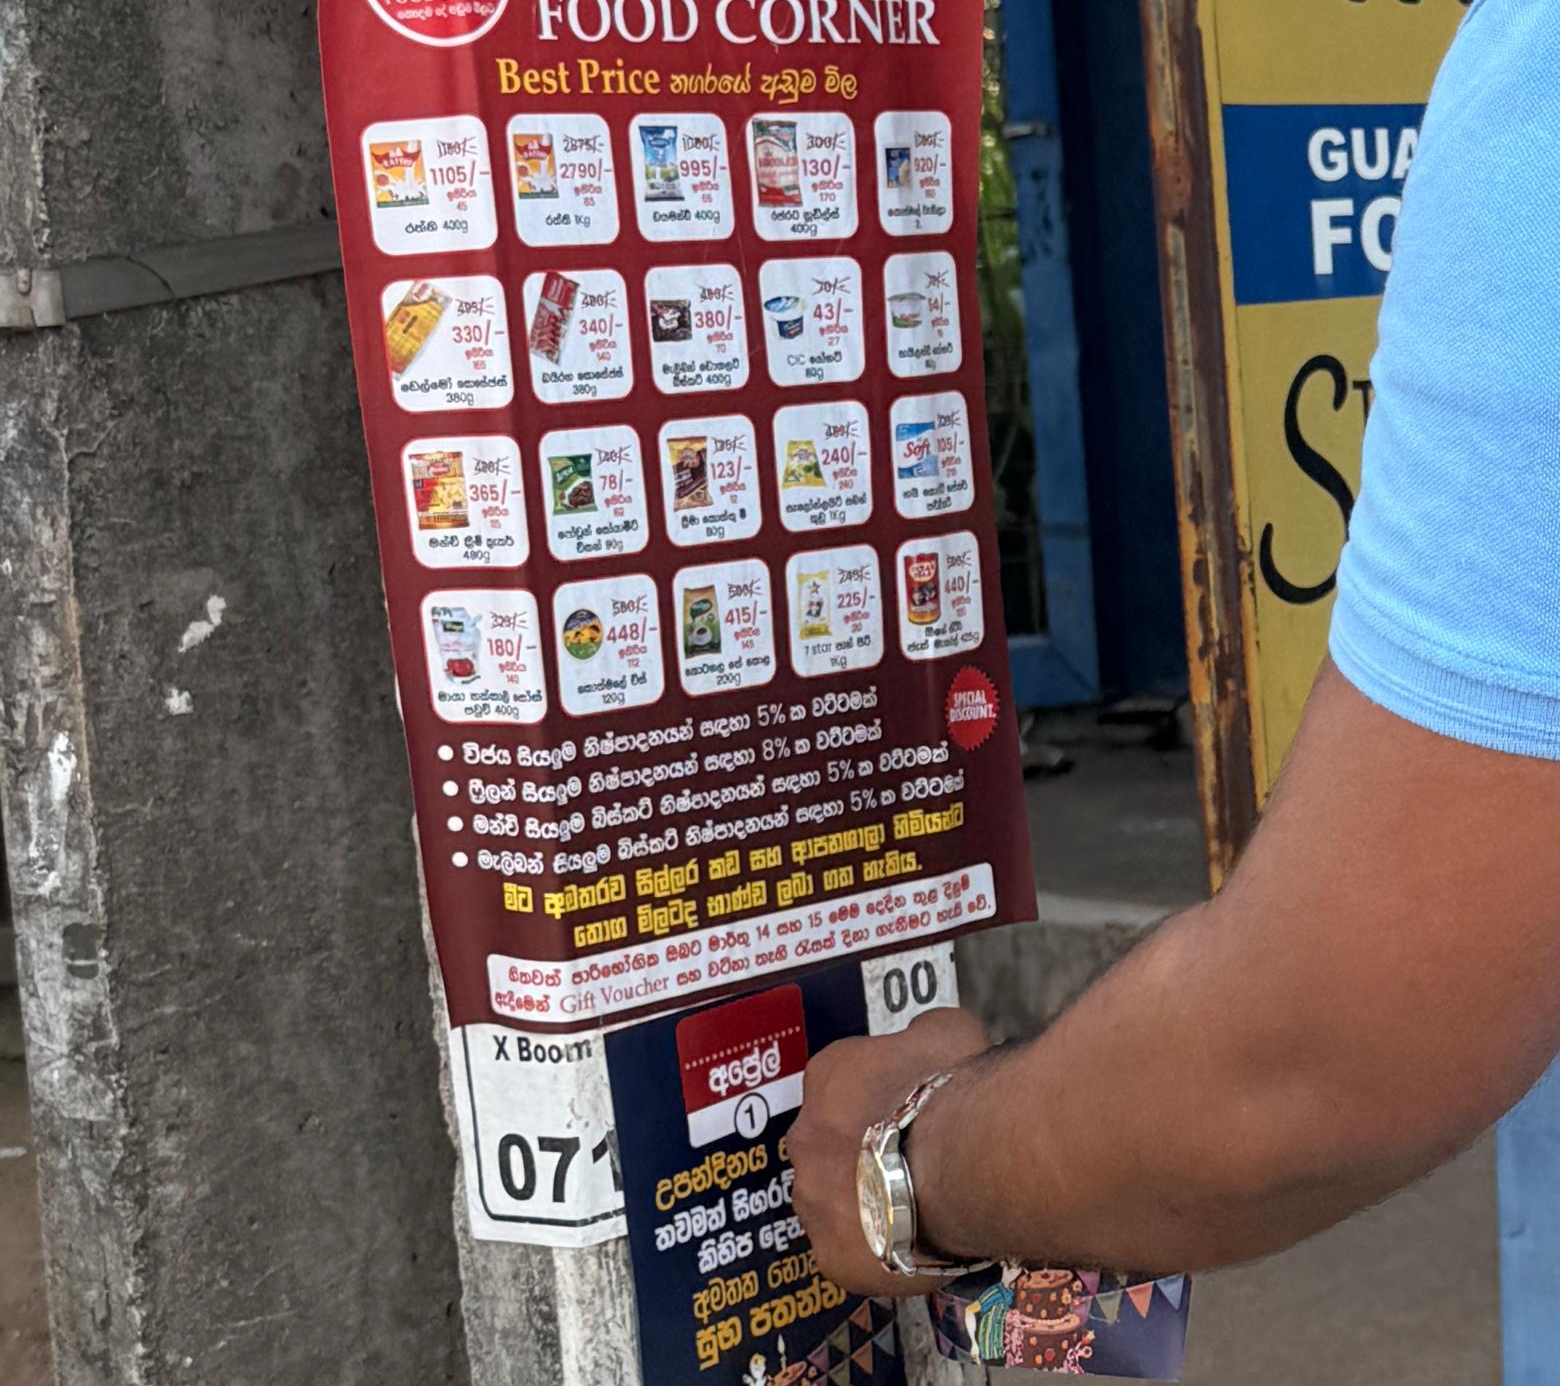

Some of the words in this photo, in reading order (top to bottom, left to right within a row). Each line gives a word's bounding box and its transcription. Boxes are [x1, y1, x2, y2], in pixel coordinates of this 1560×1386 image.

[495, 57, 572, 95] Best
[577, 57, 660, 96] Price
[669, 62, 752, 96] නගරයේ
[760, 67, 817, 105] අඩුම
[823, 65, 858, 101] මිල
[430, 159, 491, 187] 1105/-
[560, 158, 613, 182] 2790/-
[680, 155, 727, 179] 995/-
[801, 154, 851, 181] 130/-
[579, 313, 624, 338] 340/-
[694, 305, 743, 331] 380/-
[813, 298, 854, 326] 43/-
[452, 318, 506, 347] 330/-
[821, 440, 869, 467] 240/-
[903, 441, 931, 461] Soft
[599, 468, 634, 494] 78/-
[711, 455, 753, 481] 123/-
[469, 478, 522, 505] 365/-
[837, 586, 876, 609] 225/-
[724, 600, 768, 625] 415/-
[606, 615, 658, 643] 448/-
[487, 633, 537, 661] 180/-
[462, 741, 512, 765] විජය
[517, 740, 577, 770] සියලුම
[583, 718, 694, 758] නිෂ්පාදනයන්
[700, 711, 751, 739] සඳහා
[757, 703, 787, 726] 5%
[789, 704, 807, 721] ක
[812, 686, 878, 718] වට්ටමක්
[522, 776, 583, 806] සියලුම
[588, 752, 699, 794] නිෂ්පාදනයන්
[704, 745, 756, 771] සඳහා
[762, 736, 791, 761] 8%
[794, 738, 811, 755] ක
[816, 718, 883, 752] වට්ටමක්
[472, 813, 520, 838] මන්චි
[525, 813, 586, 842] සියලුම
[591, 797, 654, 830] බිස්කට්
[660, 774, 766, 816] නිෂ්පාදනයන්
[771, 768, 822, 795] සඳහා
[827, 760, 855, 783] 5%
[858, 760, 874, 776] ක
[878, 740, 950, 773] වට්ටමක්
[477, 848, 545, 876] මැලිබන්
[553, 844, 611, 874] සියලුම
[618, 827, 679, 861] බිස්කට්
[685, 804, 790, 847] නිෂ්පාදනයන්
[795, 800, 844, 825] සඳහා
[849, 789, 878, 813] 5%
[880, 788, 897, 805] ක
[901, 767, 966, 803] වට්ටමක්
[543, 874, 627, 919] අමතරව
[635, 859, 700, 899] සිල්ලර
[708, 849, 741, 881] කඩ
[750, 845, 782, 872] සහ
[756, 924, 770, 941] 14
[807, 914, 822, 930] 15
[559, 991, 596, 1015] Gift
[600, 974, 671, 1006] Voucher
[882, 959, 938, 1013] 00
[492, 1034, 511, 1062] X
[517, 1035, 593, 1064] Boom
[708, 1040, 782, 1097] අප්‍රේල්
[744, 1102, 757, 1130] 1
[655, 1143, 769, 1213] උපන්දිනය
[655, 1196, 727, 1252] තවමත්
[697, 1232, 754, 1275] කිහිප
[692, 1267, 760, 1324] අමතක
[695, 1315, 743, 1372] සුභ
